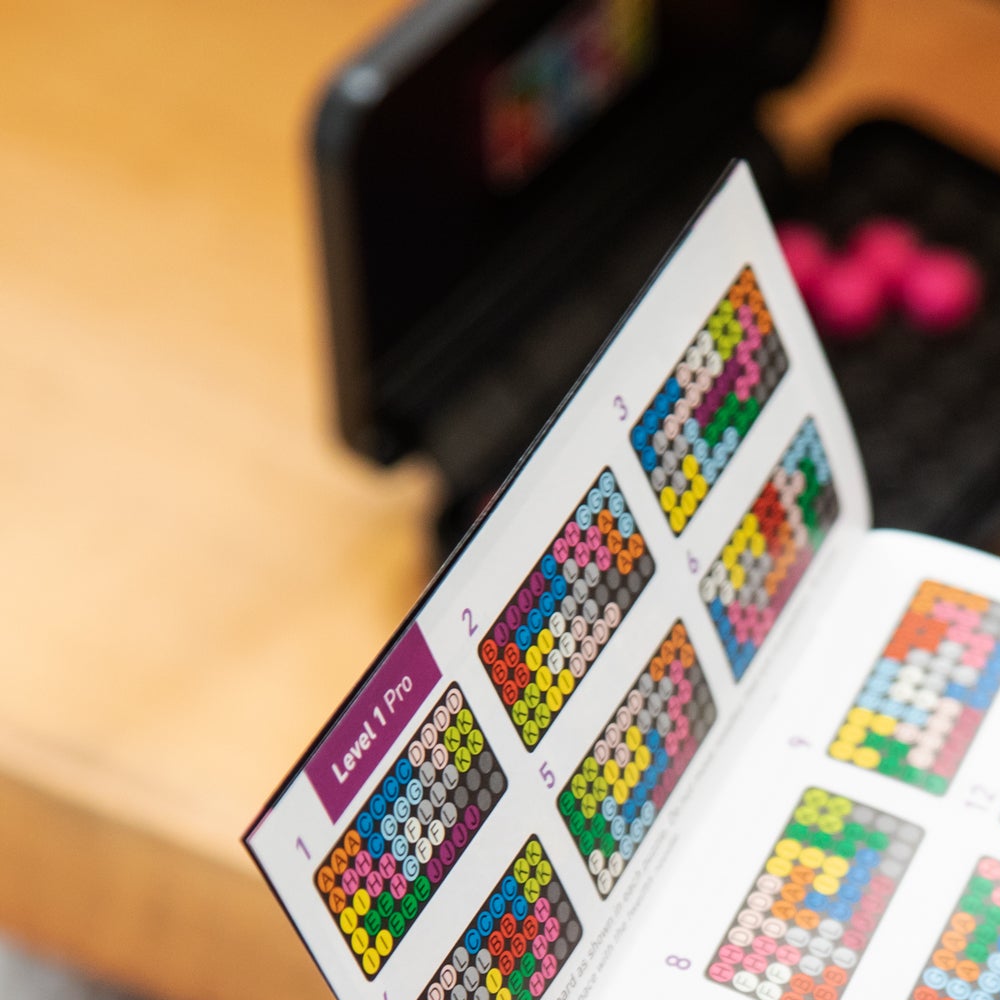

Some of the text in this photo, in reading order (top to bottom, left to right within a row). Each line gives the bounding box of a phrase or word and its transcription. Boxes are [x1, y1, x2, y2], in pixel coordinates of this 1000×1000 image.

[613, 395, 628, 422] 3
[461, 608, 478, 637] 2
[331, 675, 412, 783] Level 1 Pro
[539, 762, 556, 789] 5
[321, 692, 459, 890] A A A C C C C D D D D
[332, 713, 470, 910] A H H C G G G L D K K
[344, 733, 481, 927] I I H H G F L L L K K
[296, 837, 311, 860] 1
[576, 959, 587, 977] as
[665, 955, 691, 971] 8
